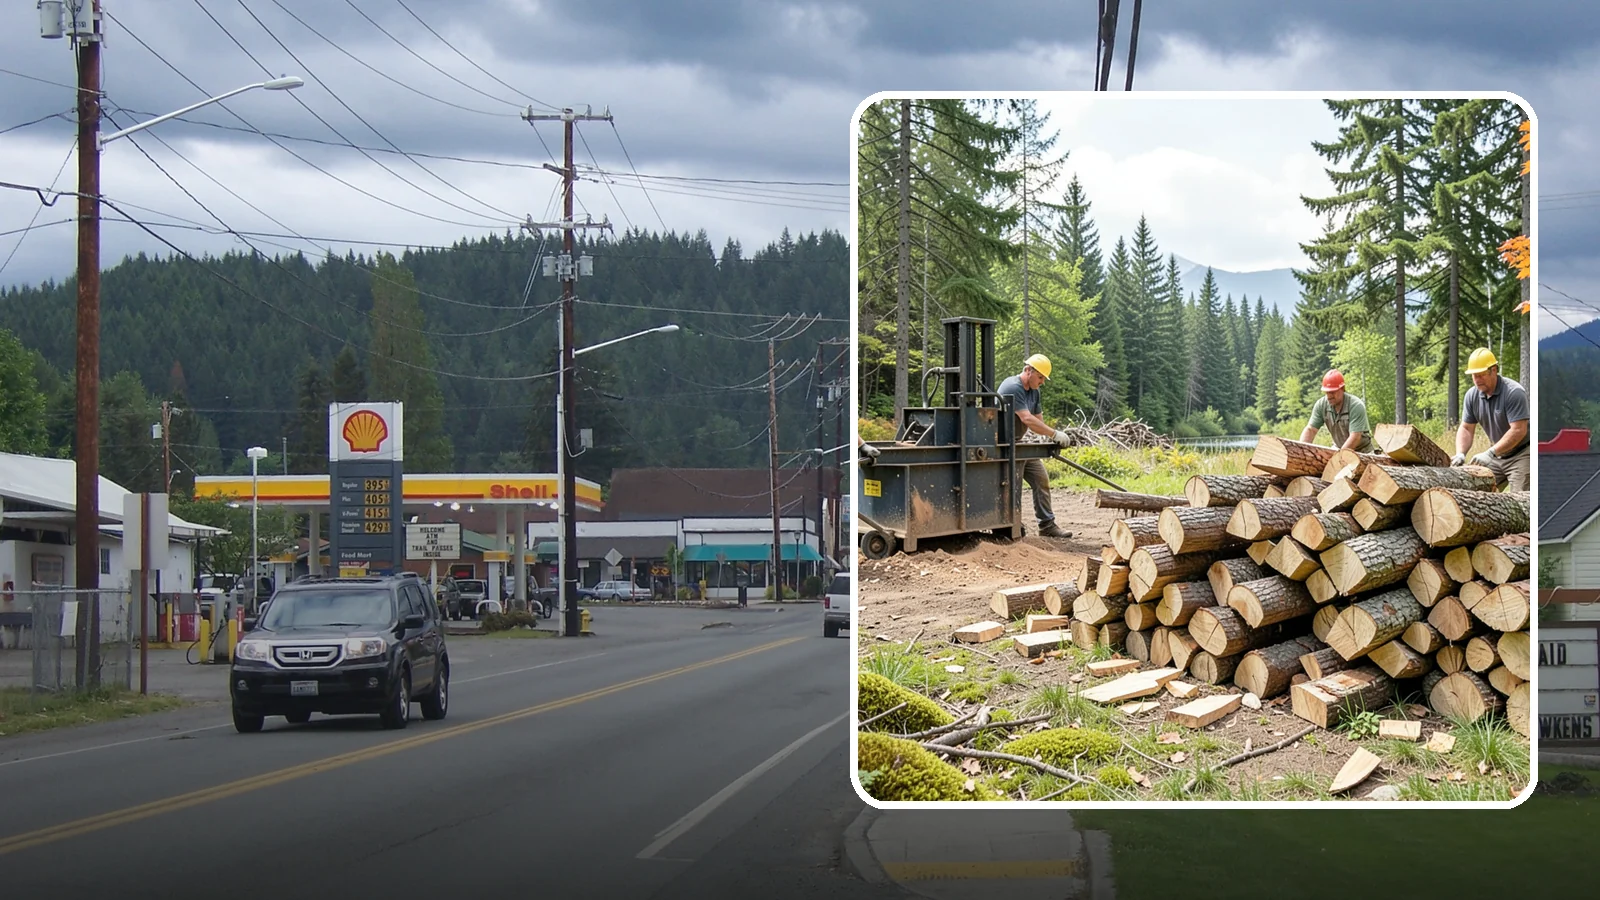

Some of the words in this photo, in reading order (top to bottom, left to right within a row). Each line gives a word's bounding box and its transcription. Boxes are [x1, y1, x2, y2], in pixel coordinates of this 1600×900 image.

[366, 480, 383, 490] 395
[490, 484, 547, 499] Shell
[366, 494, 383, 504] 405
[366, 508, 383, 518] 415
[366, 522, 383, 532] 429
